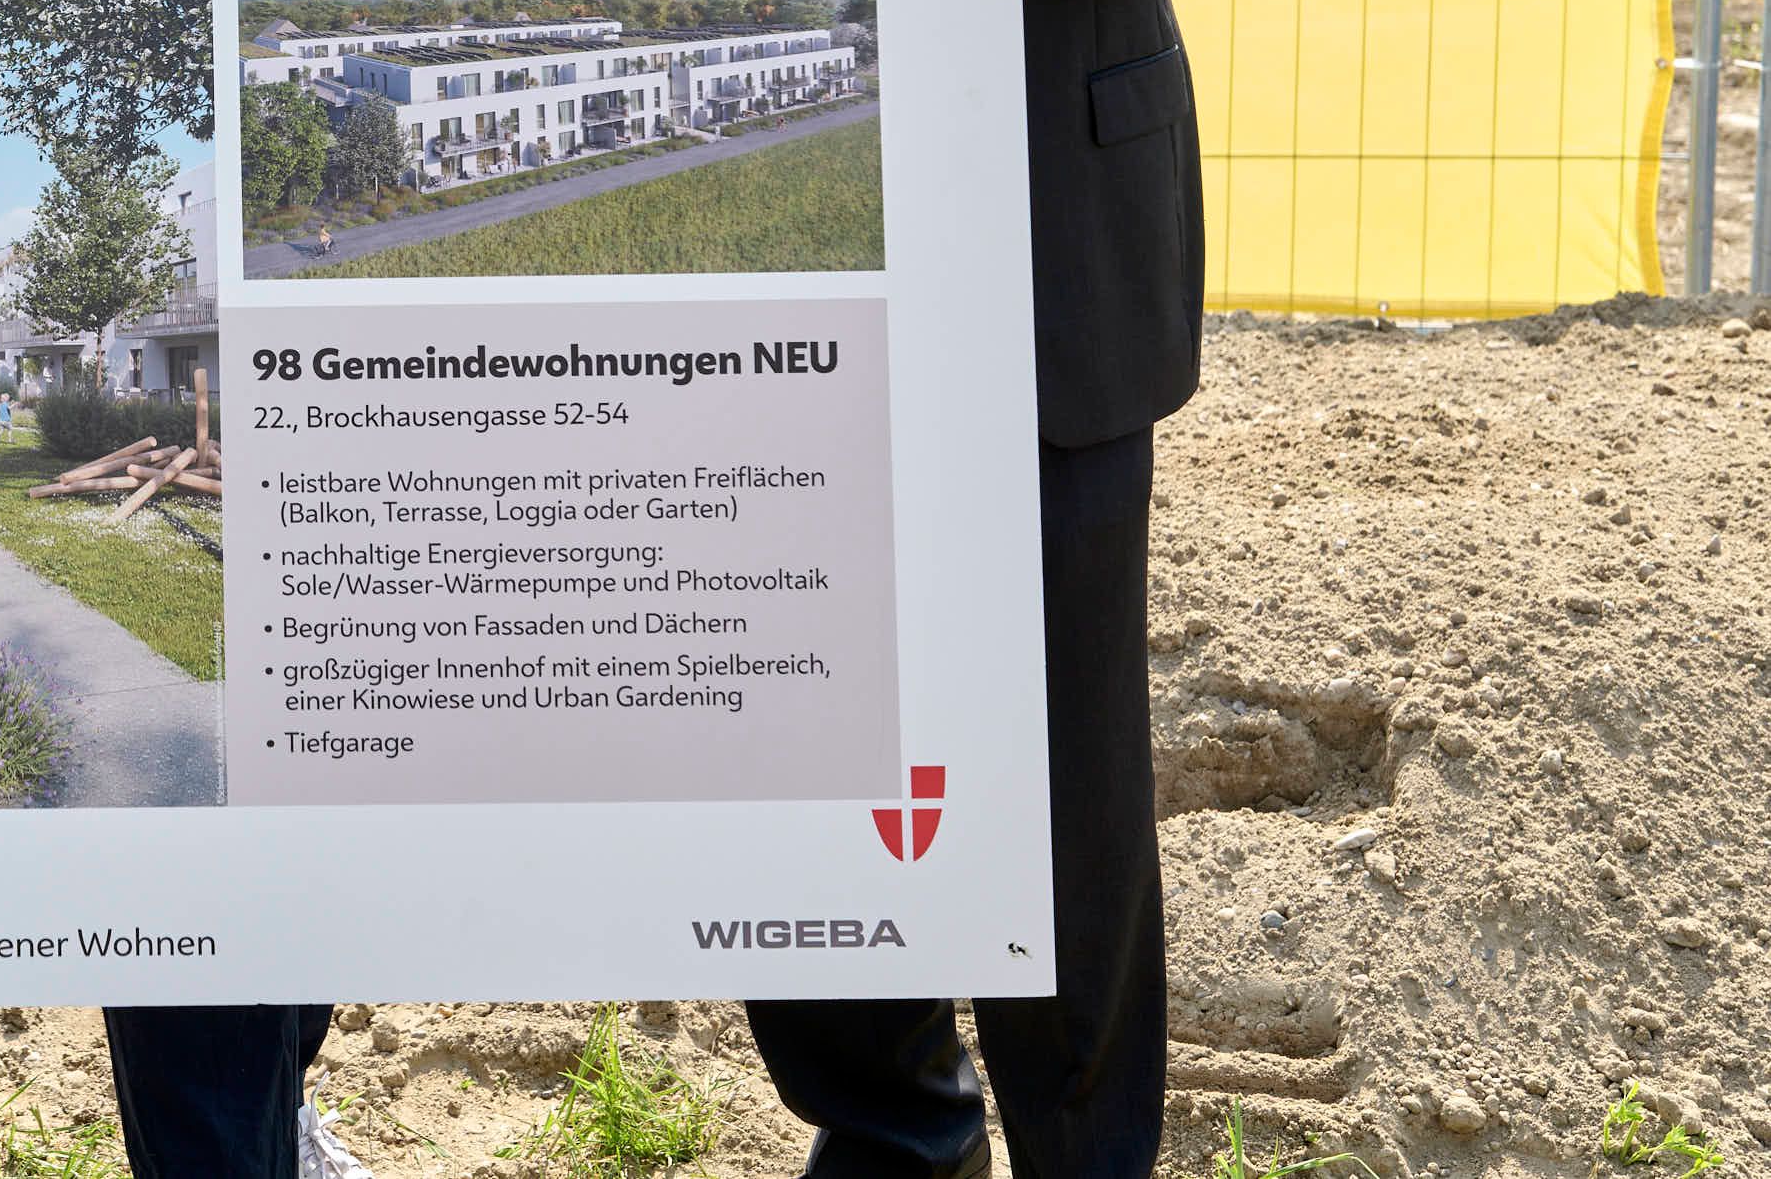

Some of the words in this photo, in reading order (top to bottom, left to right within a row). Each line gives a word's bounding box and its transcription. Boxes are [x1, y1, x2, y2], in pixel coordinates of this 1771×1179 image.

[252, 348, 302, 381] 98
[312, 343, 742, 386] Gemeindewohnungen
[753, 341, 838, 374] NEU
[254, 406, 298, 434] 22.,
[307, 404, 546, 434] Brockhausengasse
[553, 402, 629, 426] 52-54
[280, 471, 381, 494] leistbare
[387, 469, 536, 498] Wohnungen
[544, 469, 582, 490] mit
[588, 468, 687, 496] privaten
[694, 465, 825, 488] Freiflächen
[280, 500, 376, 528] (Balkon,
[382, 501, 488, 526] Terrasse,
[496, 500, 577, 527] Loggia
[583, 497, 640, 520] oder
[646, 495, 737, 522] Garten)
[281, 543, 421, 571] nachhaltige
[428, 542, 663, 570] Energieversorgung:
[282, 572, 617, 600] Sole/Wasser-Wärmepumpe
[623, 569, 669, 592] und
[677, 567, 829, 591] Photovoltaik
[283, 617, 416, 645] Begrünung
[422, 621, 467, 637] von
[475, 612, 584, 636] Fassaden
[592, 612, 637, 635] und
[645, 611, 747, 634] Dächern
[283, 657, 430, 687] großzügiger
[437, 655, 546, 679] Innenhof
[552, 656, 591, 678] mit
[597, 656, 670, 677] einem
[677, 652, 830, 682] Spielbereich,
[285, 690, 346, 711] einer
[353, 688, 475, 710] Kinowiese
[481, 686, 527, 709] und
[535, 685, 609, 708] Urban
[616, 684, 743, 713] Gardening
[284, 730, 414, 759] Tiefgarage
[77, 927, 216, 957] Wohnen
[691, 919, 907, 950] WIGEBA
